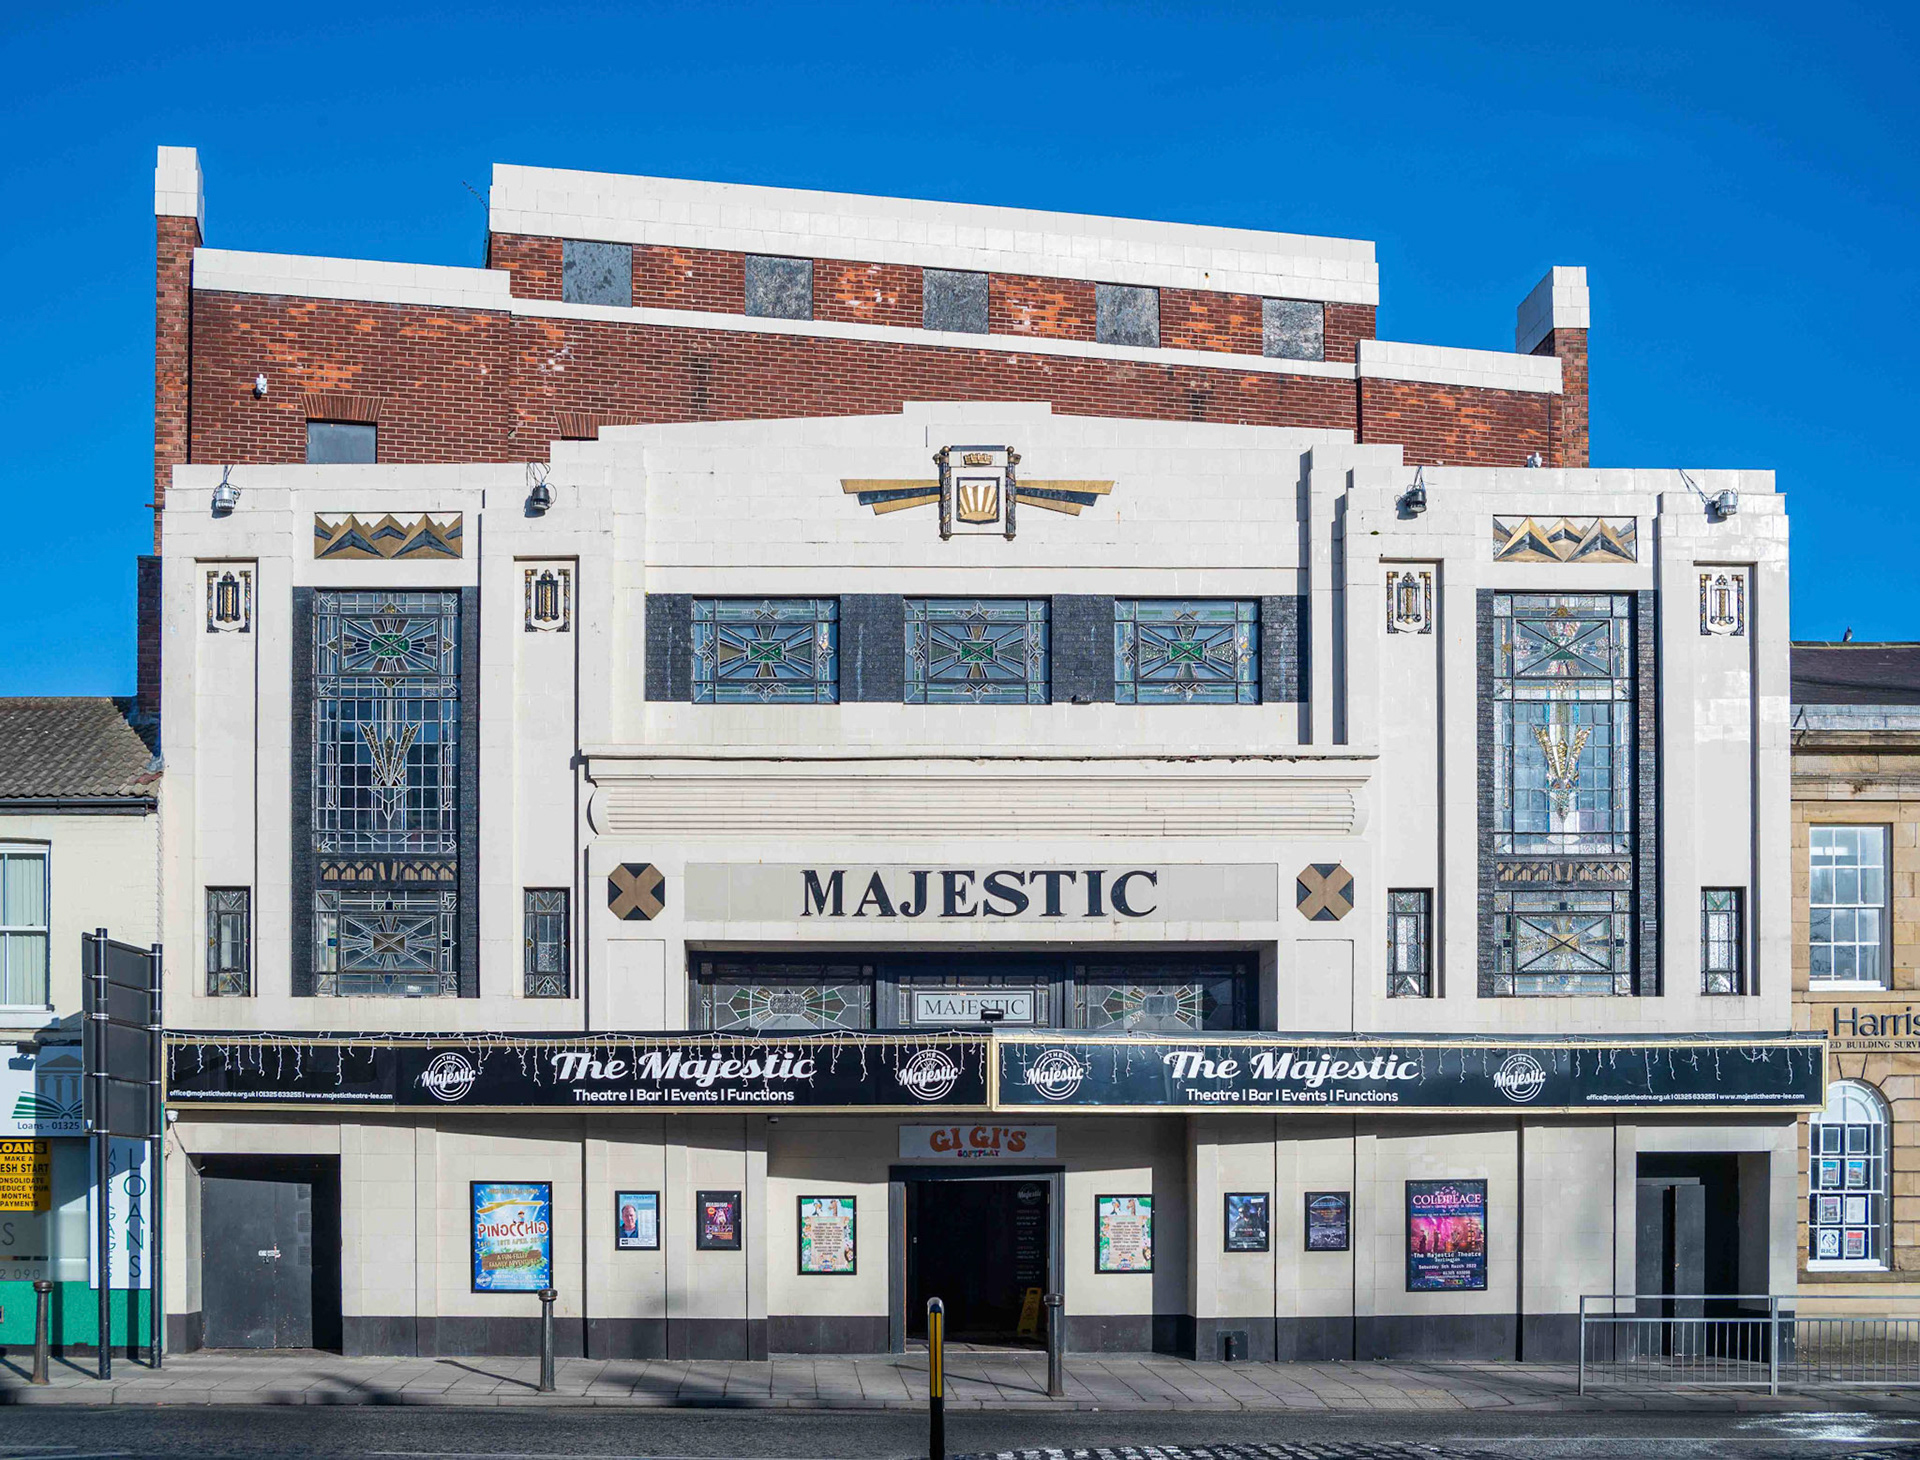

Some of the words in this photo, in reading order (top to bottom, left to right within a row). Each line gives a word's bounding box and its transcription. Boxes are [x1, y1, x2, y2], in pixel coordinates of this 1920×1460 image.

[800, 870, 1158, 918] MAJESTIC
[924, 999, 1025, 1015] MAJESTIC
[1833, 1006, 1920, 1036] Harris
[1846, 1041, 1890, 1049] BUILDING
[441, 1054, 456, 1062] THE
[551, 1052, 629, 1080] The
[638, 1052, 818, 1087] Majestic
[899, 1064, 959, 1089] Majestic
[1026, 1064, 1084, 1089] Majestic
[1163, 1051, 1241, 1079] The
[1250, 1052, 1420, 1088] Majestic
[421, 1068, 476, 1089] Majestic
[1493, 1069, 1547, 1091] Majestic
[169, 1089, 255, 1099] office@majestictheatre.org.uk
[573, 1089, 628, 1101] Theatre
[637, 1089, 662, 1101] Bar
[671, 1089, 718, 1101] Events
[727, 1089, 794, 1101] Functions
[1185, 1089, 1240, 1102] Theatre
[1249, 1089, 1273, 1102] Bar
[1282, 1089, 1328, 1102] Events
[1336, 1089, 1399, 1102] Functions
[1586, 1093, 1670, 1102] office@majestictheatre.org.uk
[17, 1122, 44, 1130] Loans
[51, 1122, 80, 1130] 01325
[929, 1127, 963, 1152] GI
[969, 1126, 1027, 1152] GI'S
[0, 1143, 44, 1153] OANS
[21, 1164, 49, 1173] START
[1412, 1193, 1482, 1205] COLDPLACE
[123, 1148, 147, 1278] LOANS
[477, 1220, 548, 1238] PINOCCHIO
[14, 1269, 40, 1280] 090
